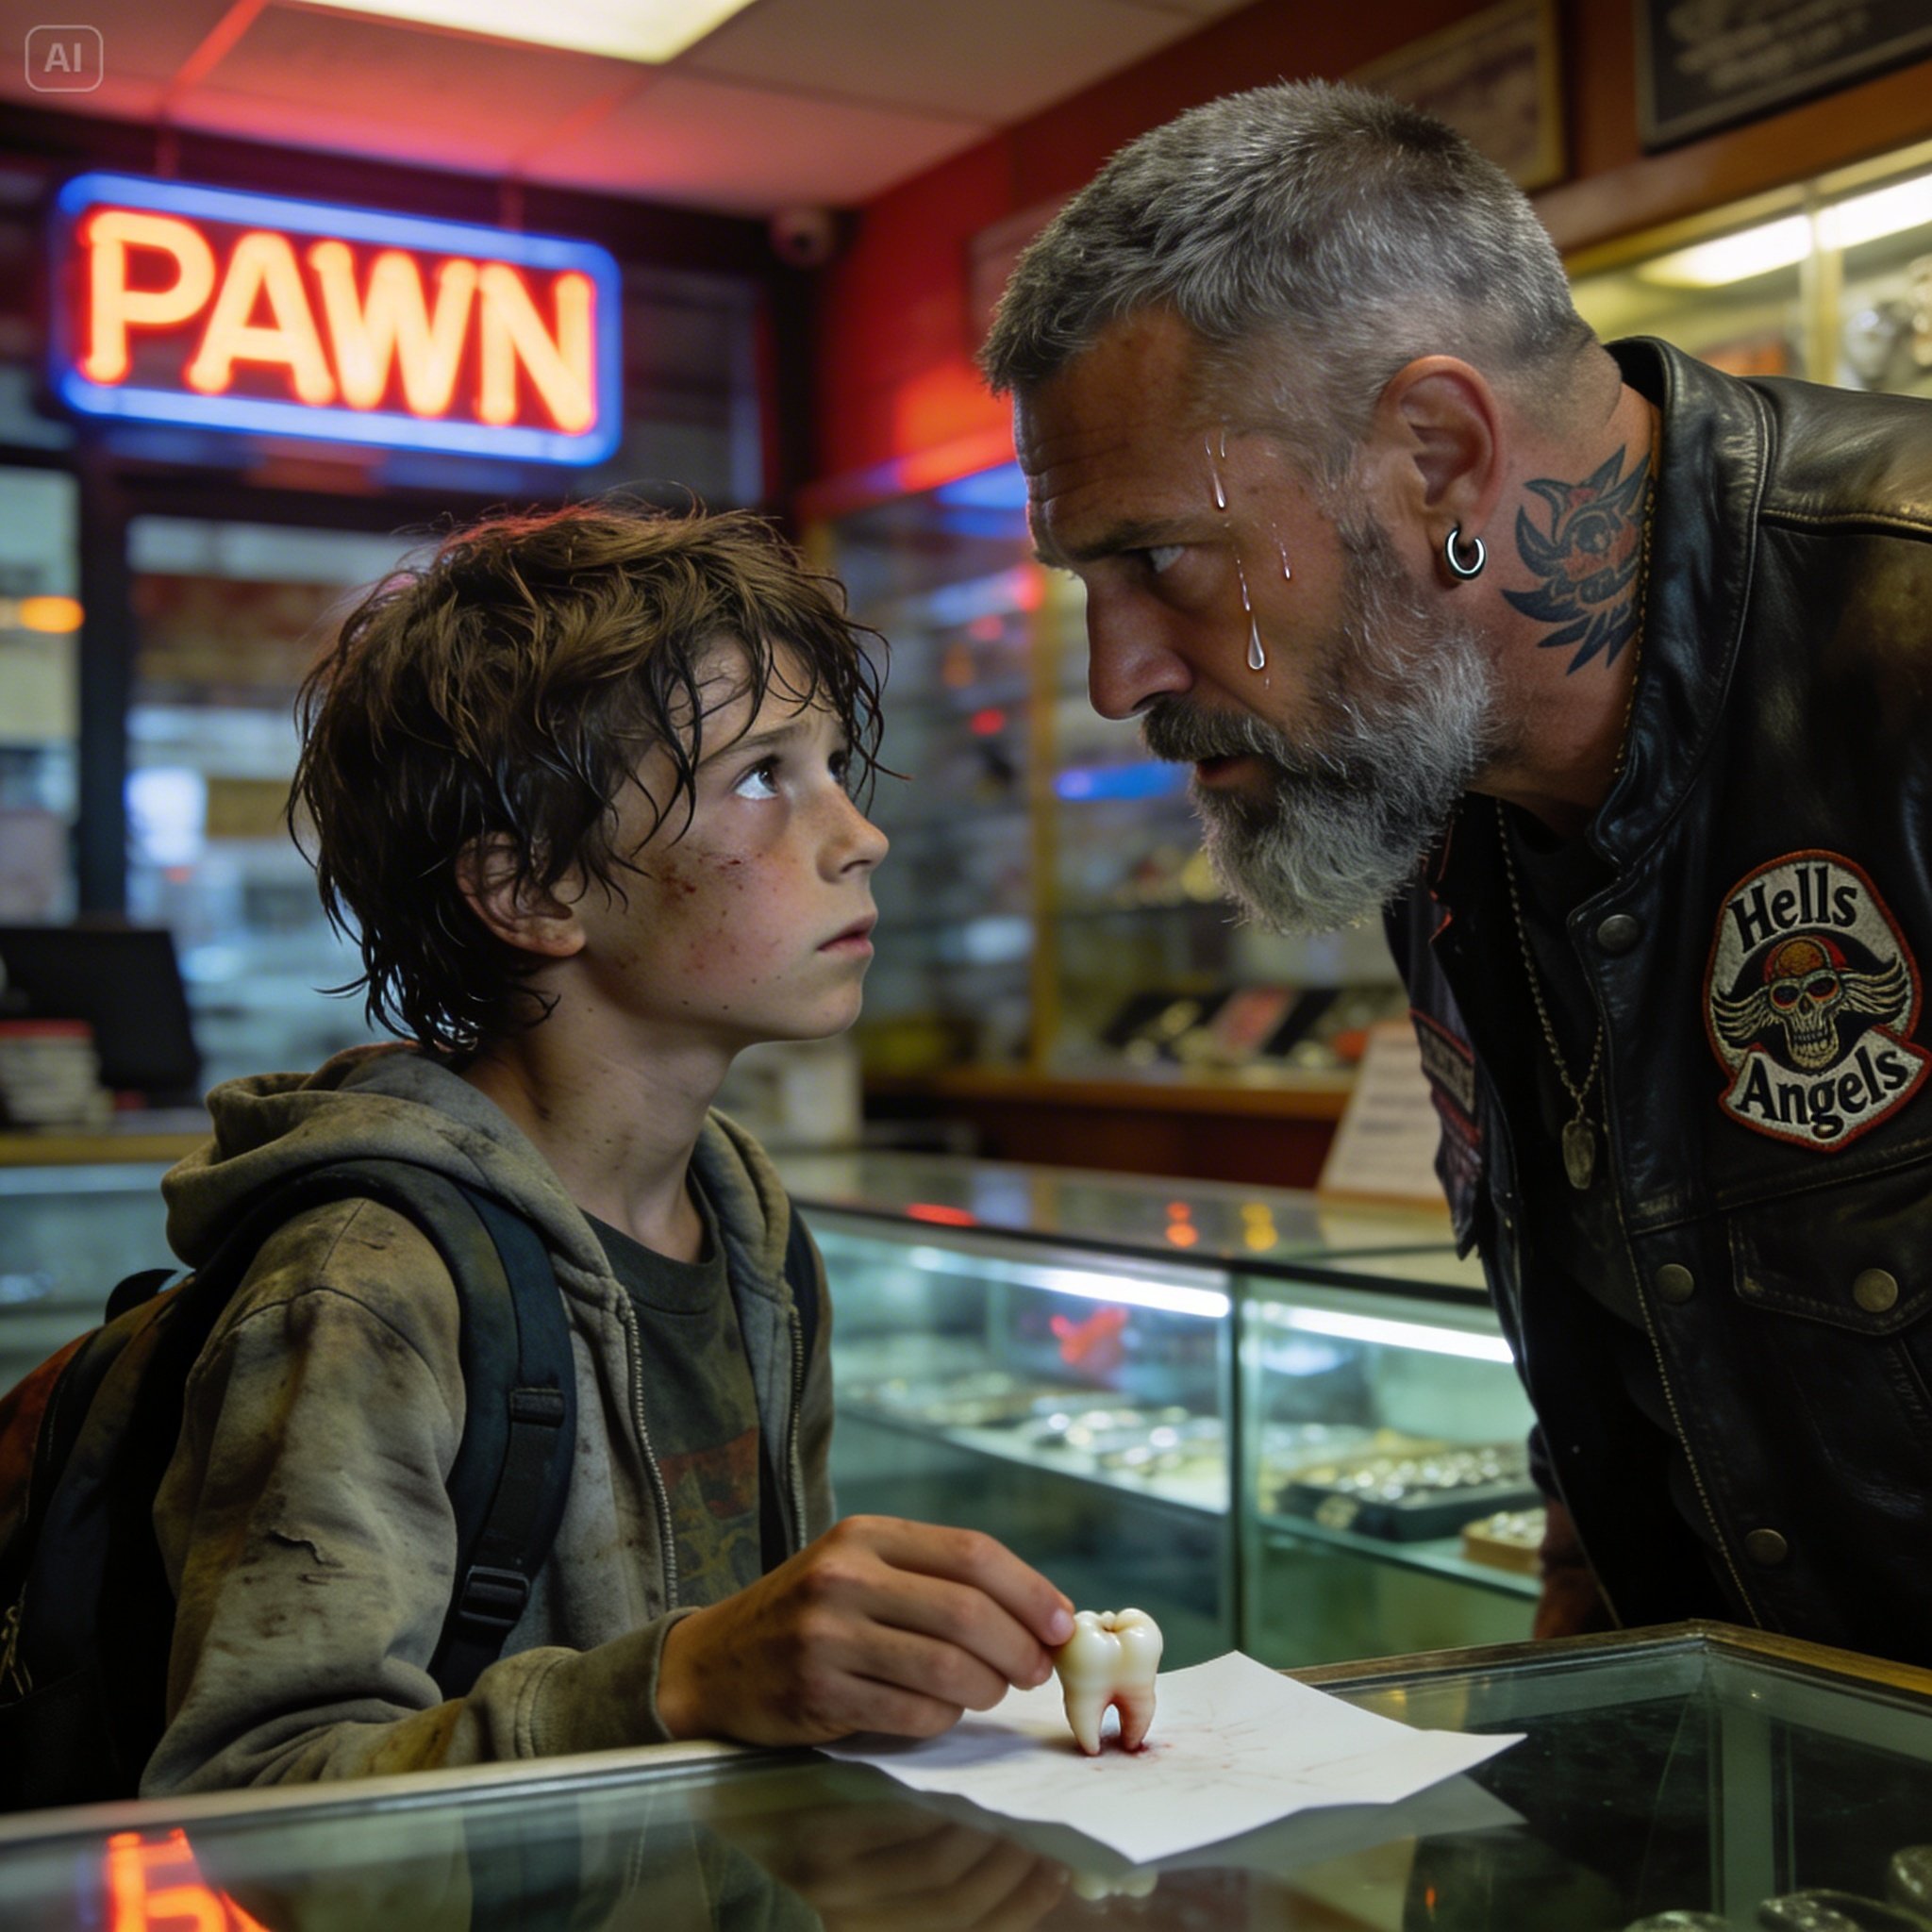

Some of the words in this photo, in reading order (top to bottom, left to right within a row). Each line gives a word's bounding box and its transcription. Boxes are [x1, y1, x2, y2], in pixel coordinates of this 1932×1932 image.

[83, 208, 596, 436] PAWN
[1728, 866, 1857, 954] Hells
[1735, 1045, 1909, 1139] Angels
